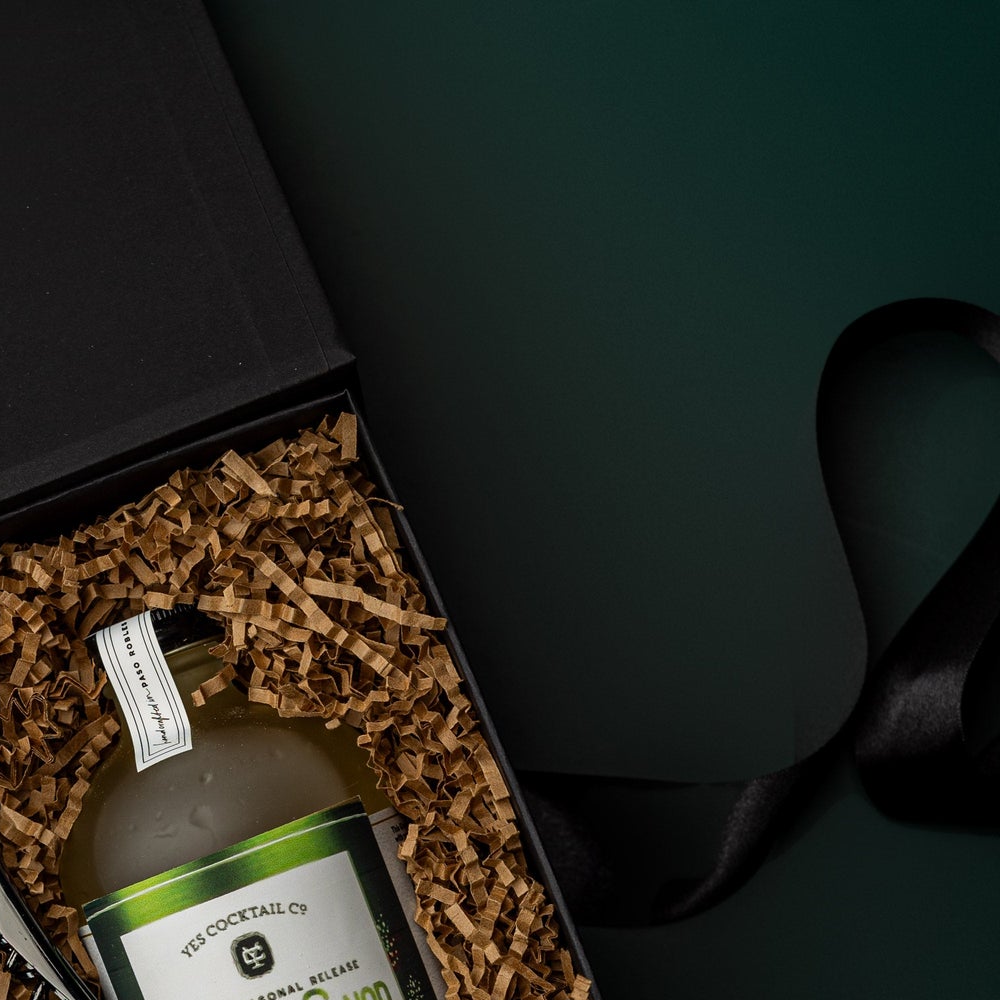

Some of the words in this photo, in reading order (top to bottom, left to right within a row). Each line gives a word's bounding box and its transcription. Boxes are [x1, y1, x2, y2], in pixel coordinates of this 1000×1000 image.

[120, 622, 136, 657] ROBLES
[133, 662, 148, 688] PASO
[181, 933, 206, 958] YES
[206, 902, 286, 937] COCKTAIL
[308, 959, 360, 986] RELEASE
